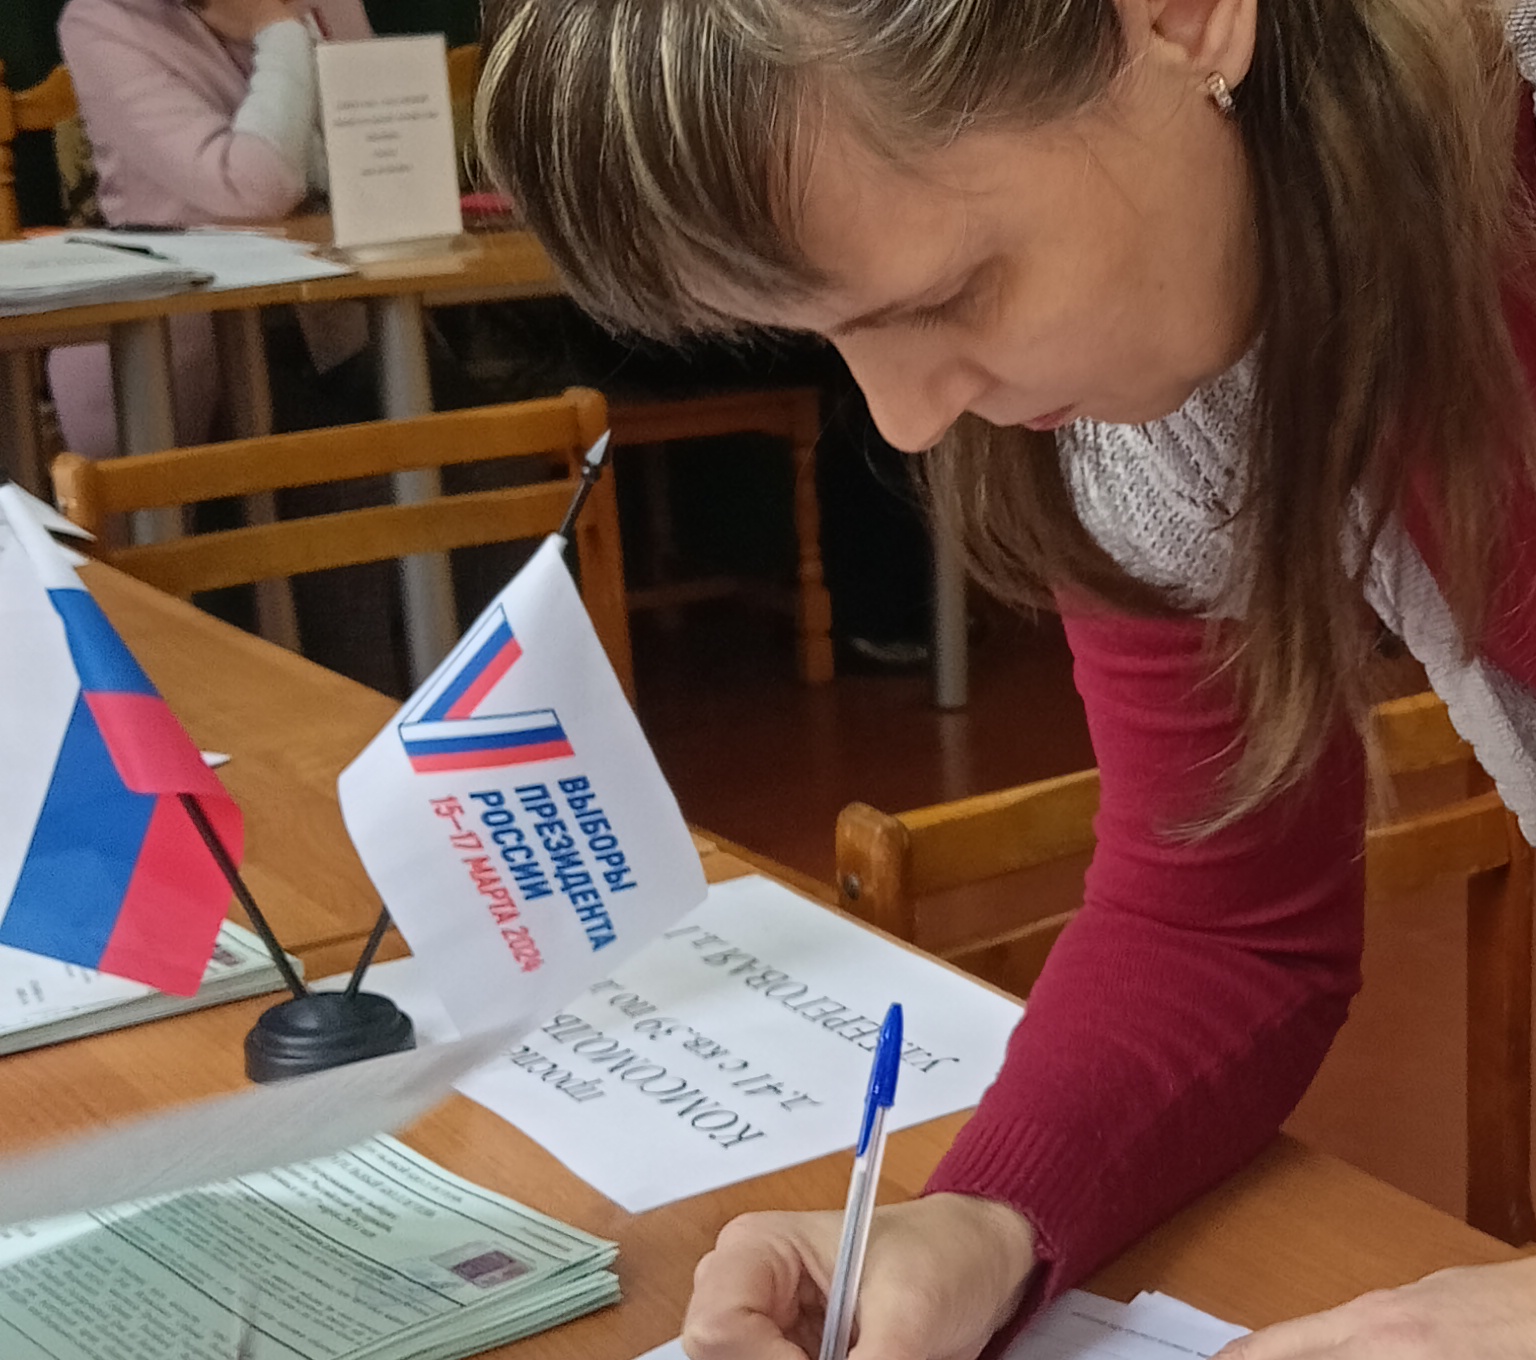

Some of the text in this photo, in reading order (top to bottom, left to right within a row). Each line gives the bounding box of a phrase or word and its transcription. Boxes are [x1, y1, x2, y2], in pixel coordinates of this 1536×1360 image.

[469, 789, 554, 901] РОССИИ
[514, 783, 618, 952] ПРЕЗИДЕНТА
[558, 775, 637, 893] ВЫБОРЫ
[462, 856, 518, 926] МАРТА
[501, 924, 545, 973] 2024
